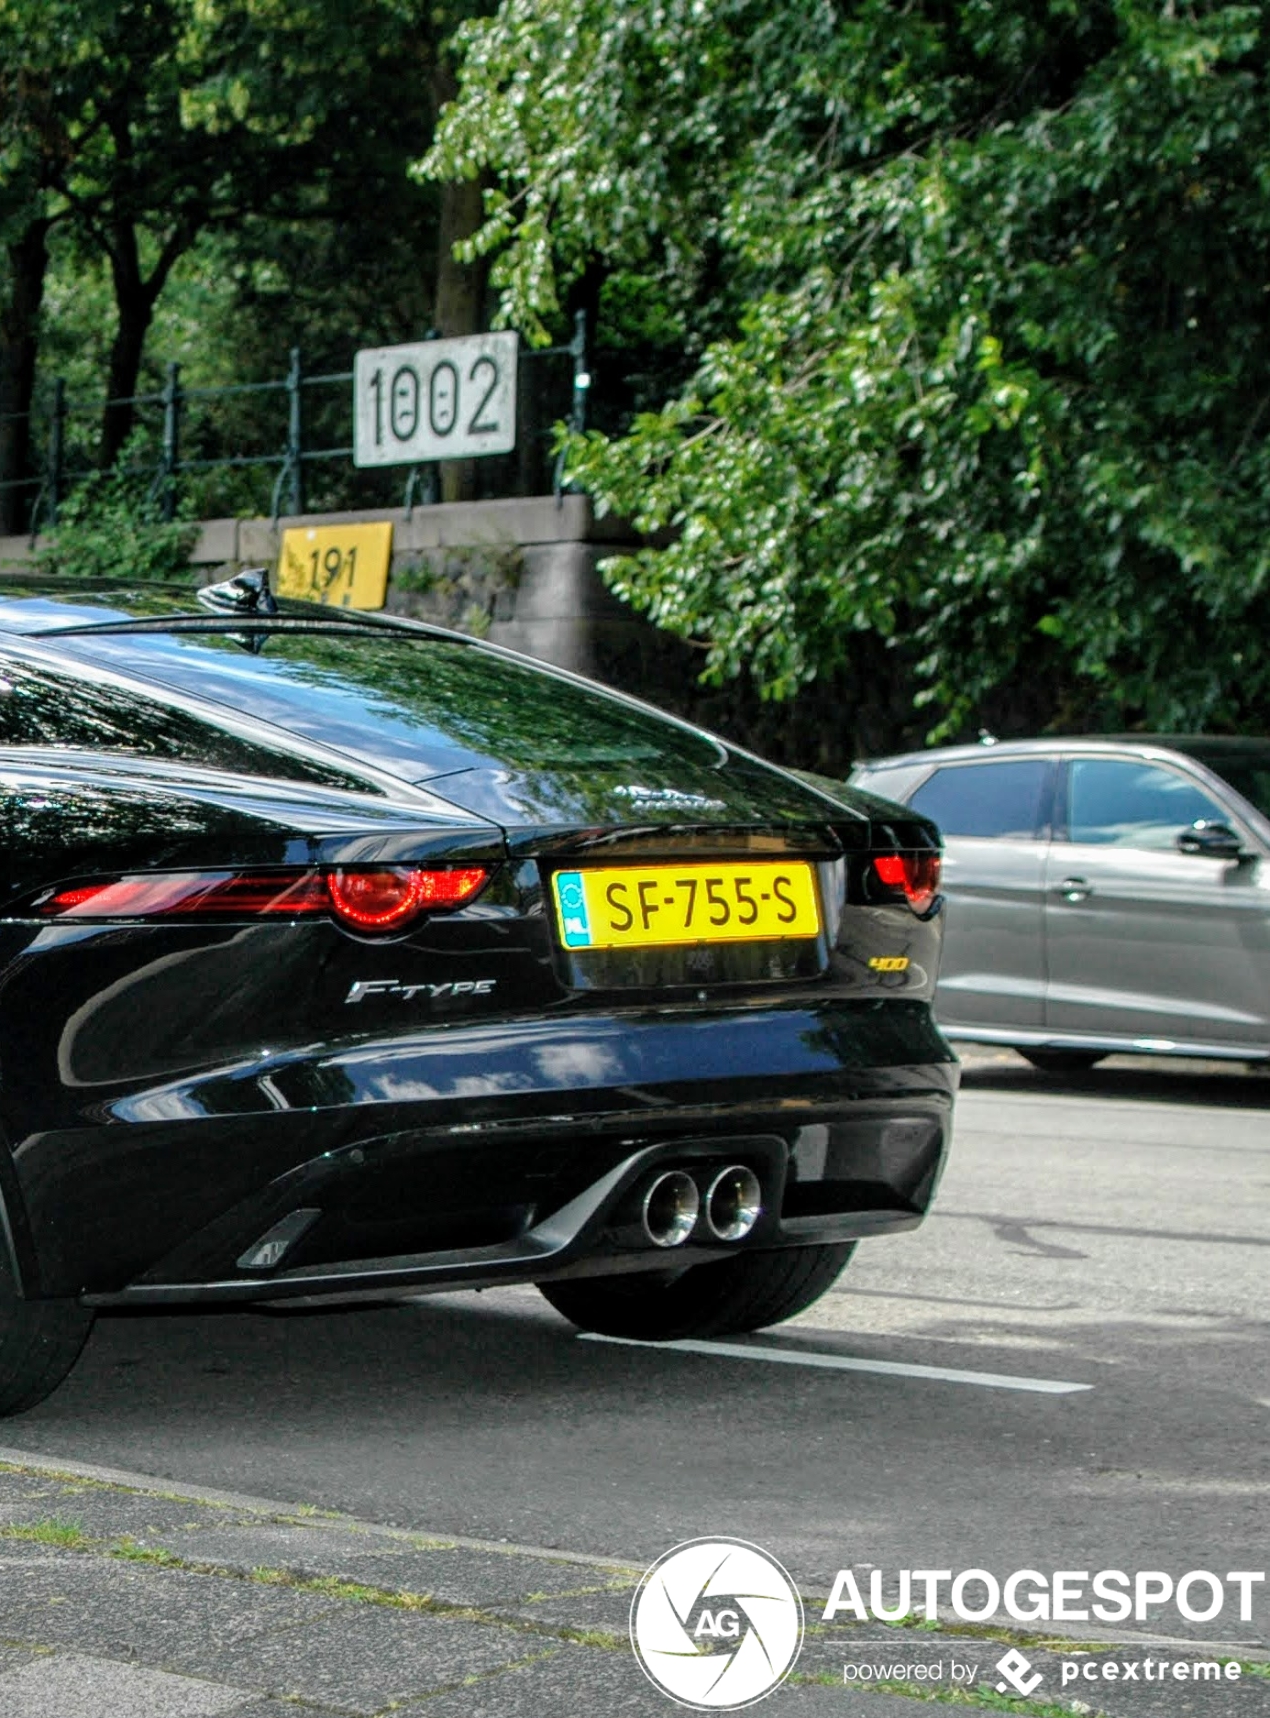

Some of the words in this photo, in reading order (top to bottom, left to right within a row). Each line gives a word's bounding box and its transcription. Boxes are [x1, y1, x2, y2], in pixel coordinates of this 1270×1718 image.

[370, 357, 499, 446] 1002
[310, 547, 357, 591] 191
[606, 876, 797, 932] SF-755-S
[868, 956, 909, 972] 400
[344, 979, 497, 1004] F-TYPE
